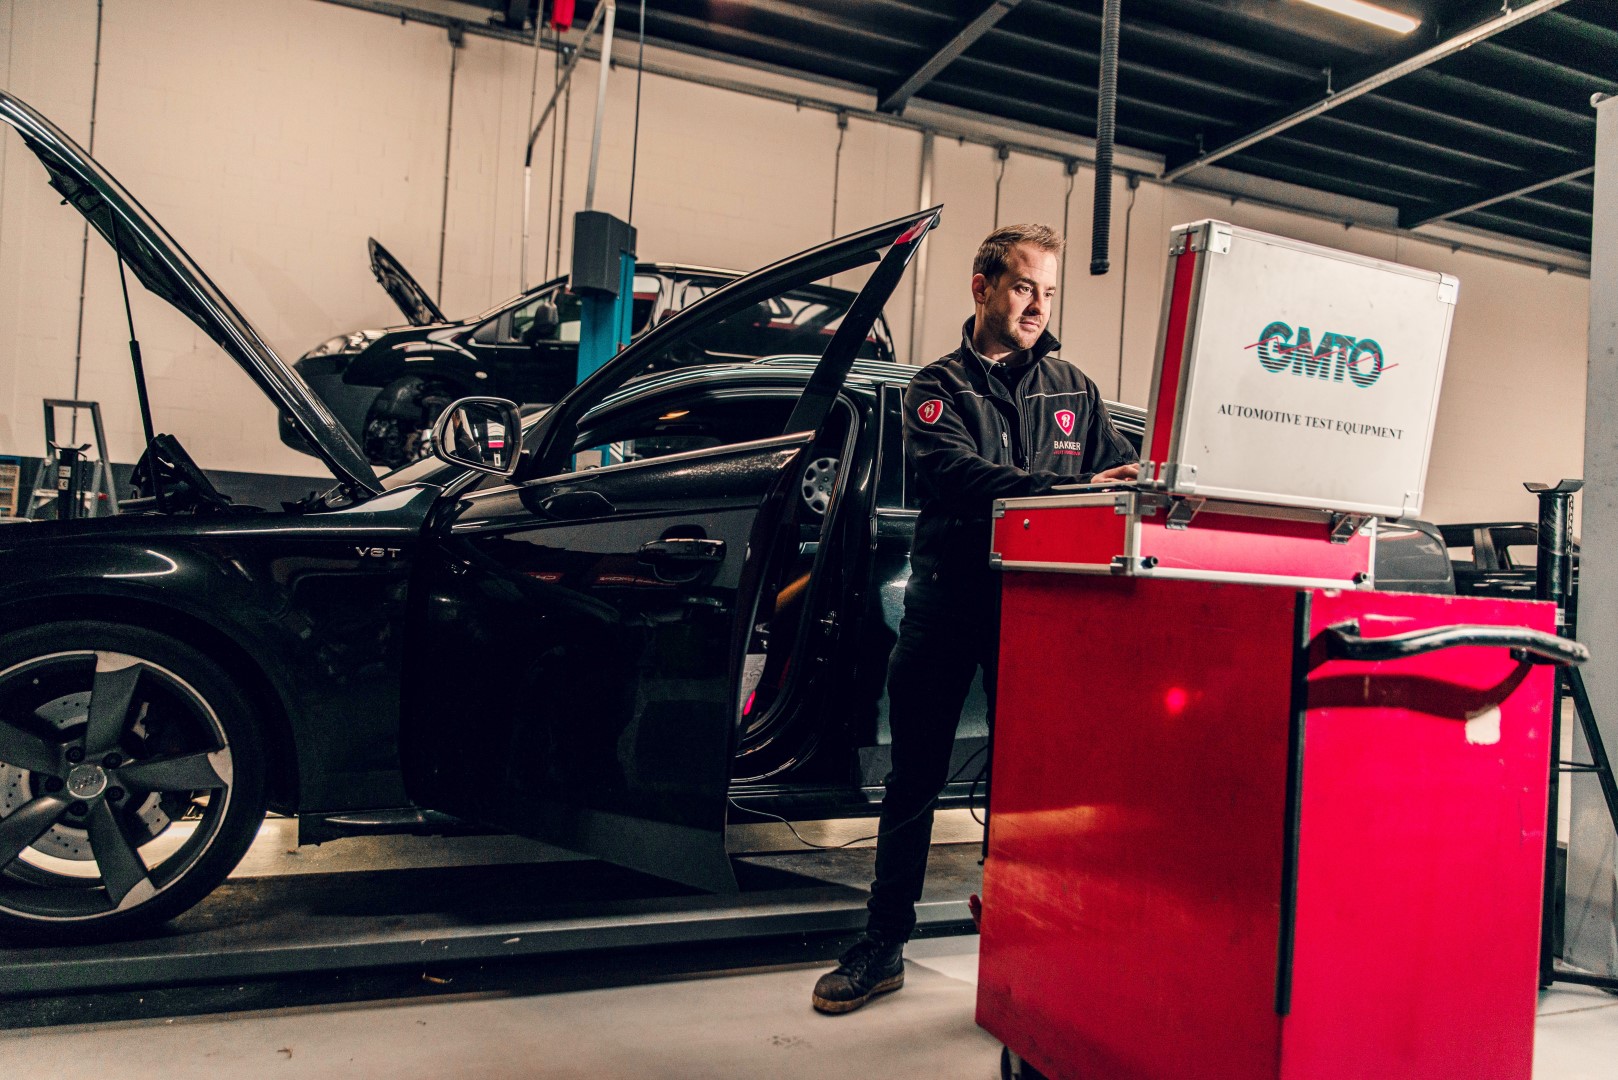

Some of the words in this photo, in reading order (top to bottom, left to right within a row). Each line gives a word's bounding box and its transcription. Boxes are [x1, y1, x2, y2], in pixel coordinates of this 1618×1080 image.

[1257, 321, 1384, 388] GMTO
[1217, 403, 1301, 426] AUTOMOTIVE
[1304, 415, 1334, 430] TEST
[1336, 420, 1404, 440] EQUIPMENT
[1053, 440, 1081, 451] BAKKER
[355, 546, 401, 558] V6T
